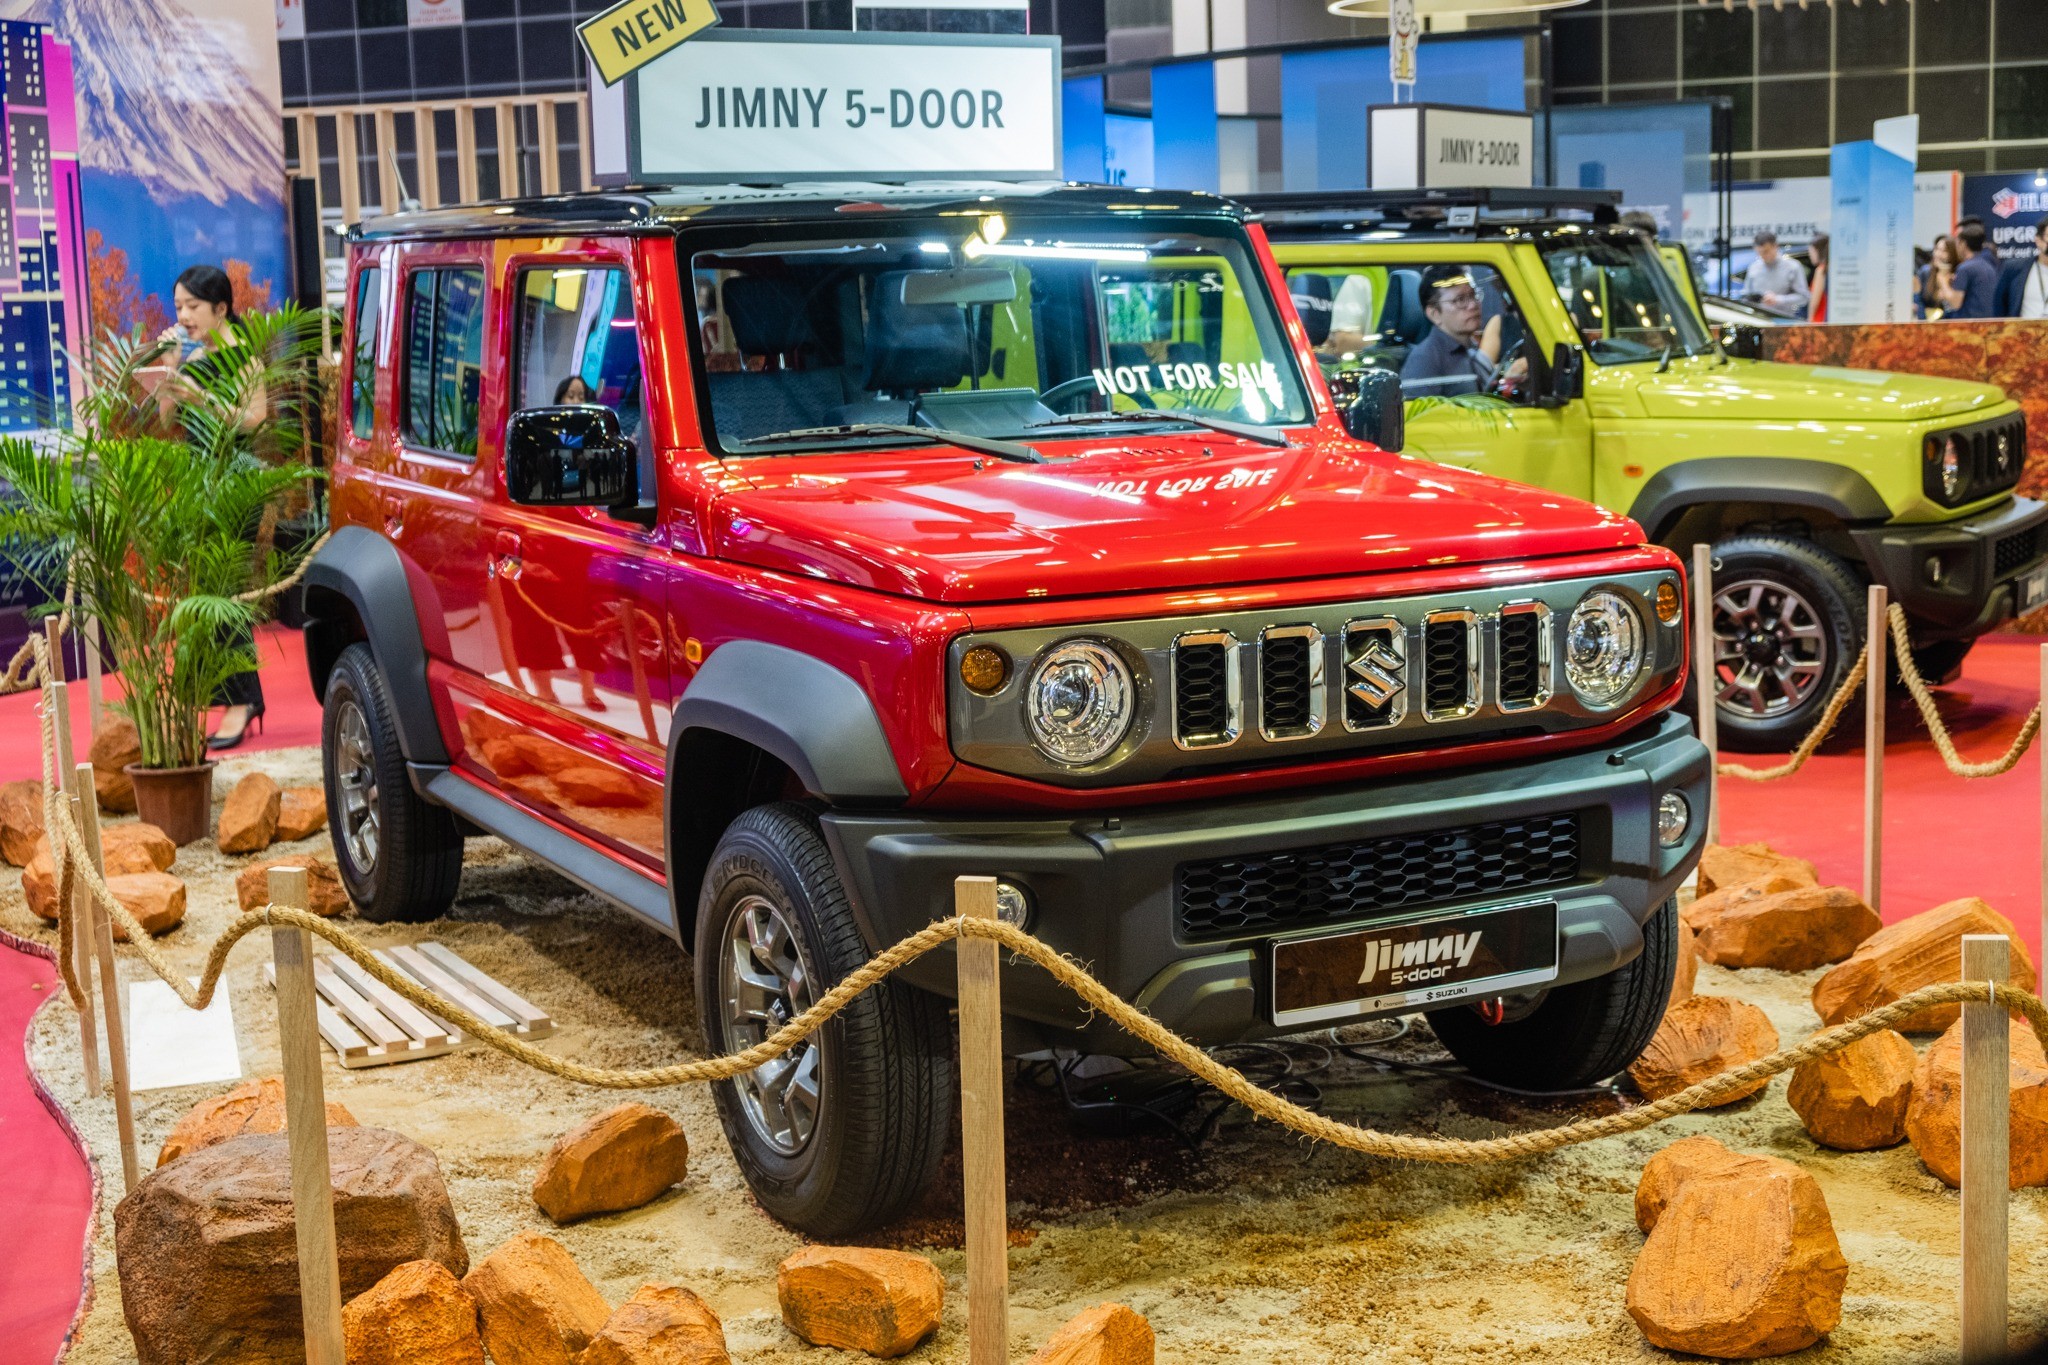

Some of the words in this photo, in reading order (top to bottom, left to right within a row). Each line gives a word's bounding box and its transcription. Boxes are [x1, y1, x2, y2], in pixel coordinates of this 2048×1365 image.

[611, 0, 687, 58] NEW
[695, 86, 828, 128] JIMNY
[845, 88, 1005, 129] 5-DOOR
[1440, 137, 1475, 163] JIMNY
[1478, 141, 1520, 166] 3-DOOR
[1776, 222, 1817, 236] RATES
[1992, 225, 2038, 244] UPGR
[1092, 365, 1151, 396] NOT
[1158, 363, 1216, 391] FOR
[1357, 931, 1483, 984] Jimny
[1390, 965, 1452, 985] 5-door
[1435, 987, 1468, 999] SUZUKI
